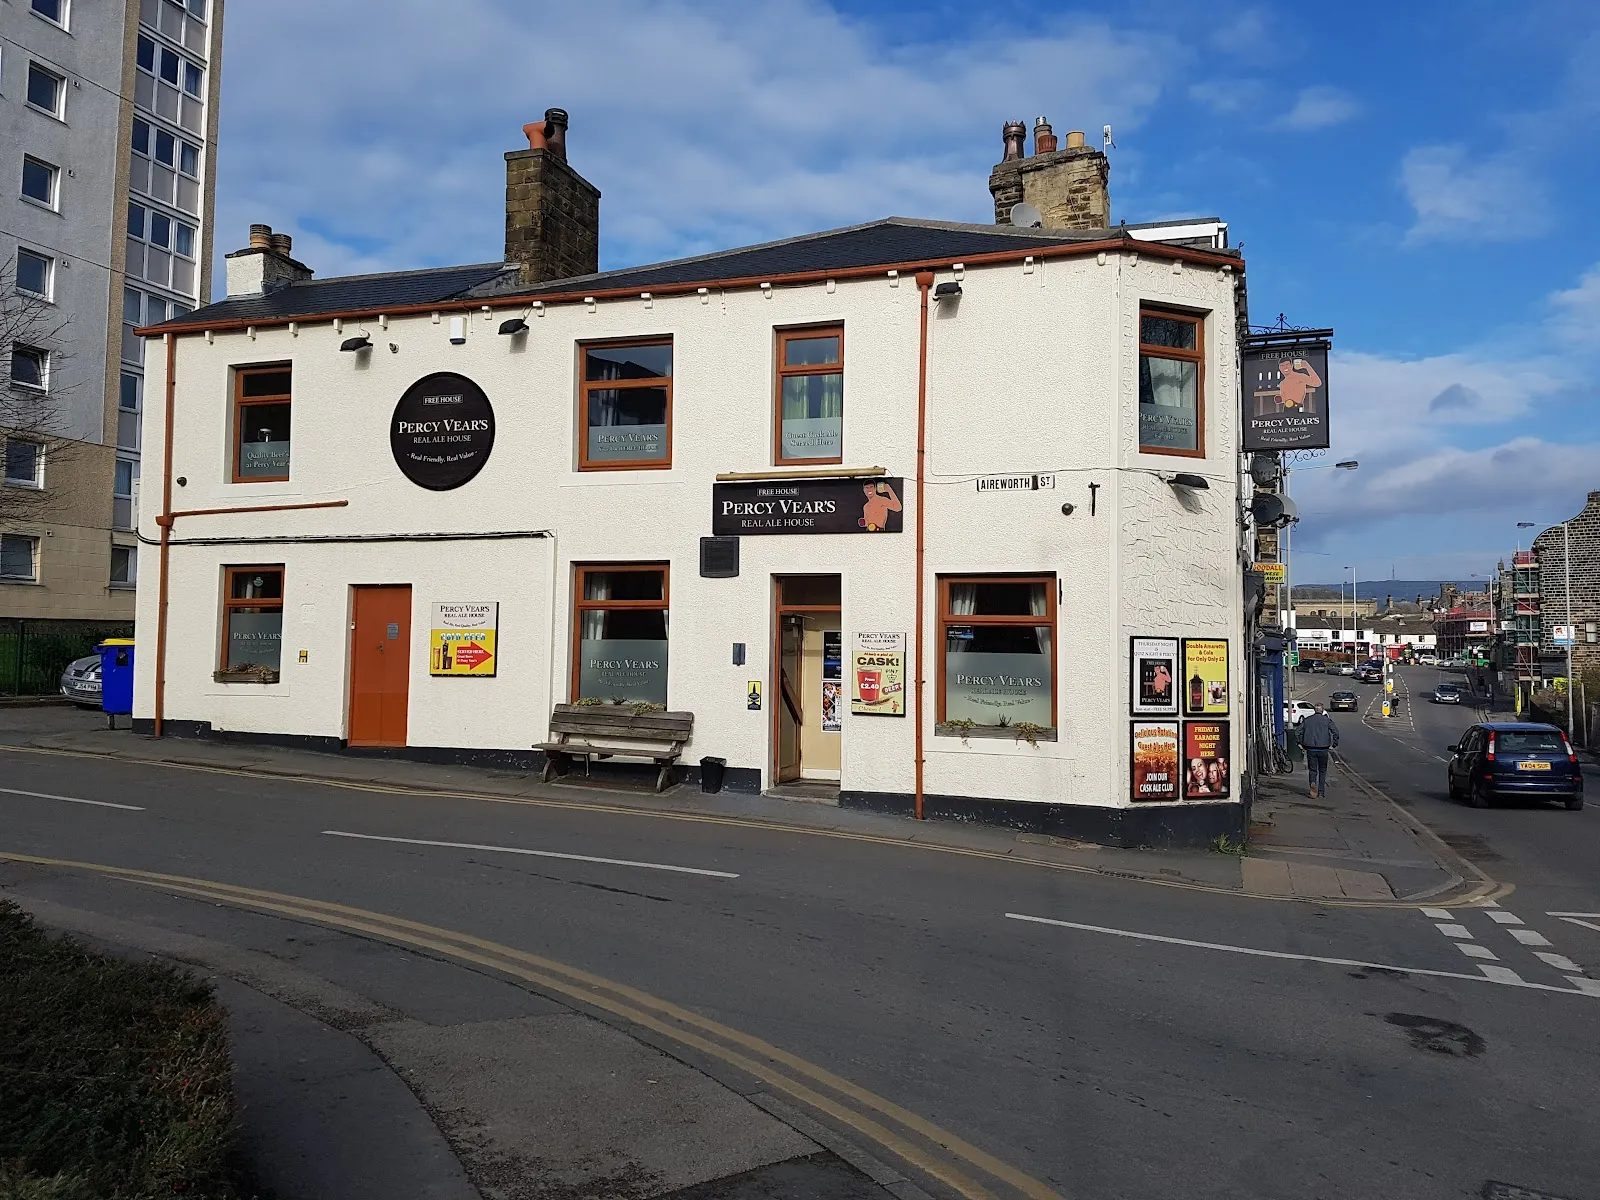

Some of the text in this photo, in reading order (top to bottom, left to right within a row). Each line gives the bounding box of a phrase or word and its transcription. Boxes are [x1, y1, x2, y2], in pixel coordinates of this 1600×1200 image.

[398, 419, 489, 434] PERCY VEAR'S
[1251, 417, 1320, 428] PERCY VEAR'S
[598, 434, 627, 443] PERCY
[247, 452, 268, 460] Quality
[410, 452, 422, 460] Real
[459, 451, 474, 460] Value
[980, 478, 1030, 490] AIREWORTH
[775, 487, 798, 495] HOUSE
[722, 499, 836, 516] PERCY VEAR'S
[742, 518, 814, 528] REAL ALE HOUSE
[590, 660, 659, 669] PERCY VEAR'S
[857, 656, 899, 666] CASK!
[956, 674, 1042, 687] PERCY VEAR'S
[1146, 773, 1168, 781] JOIN OUR
[1140, 784, 1152, 792] CASK
